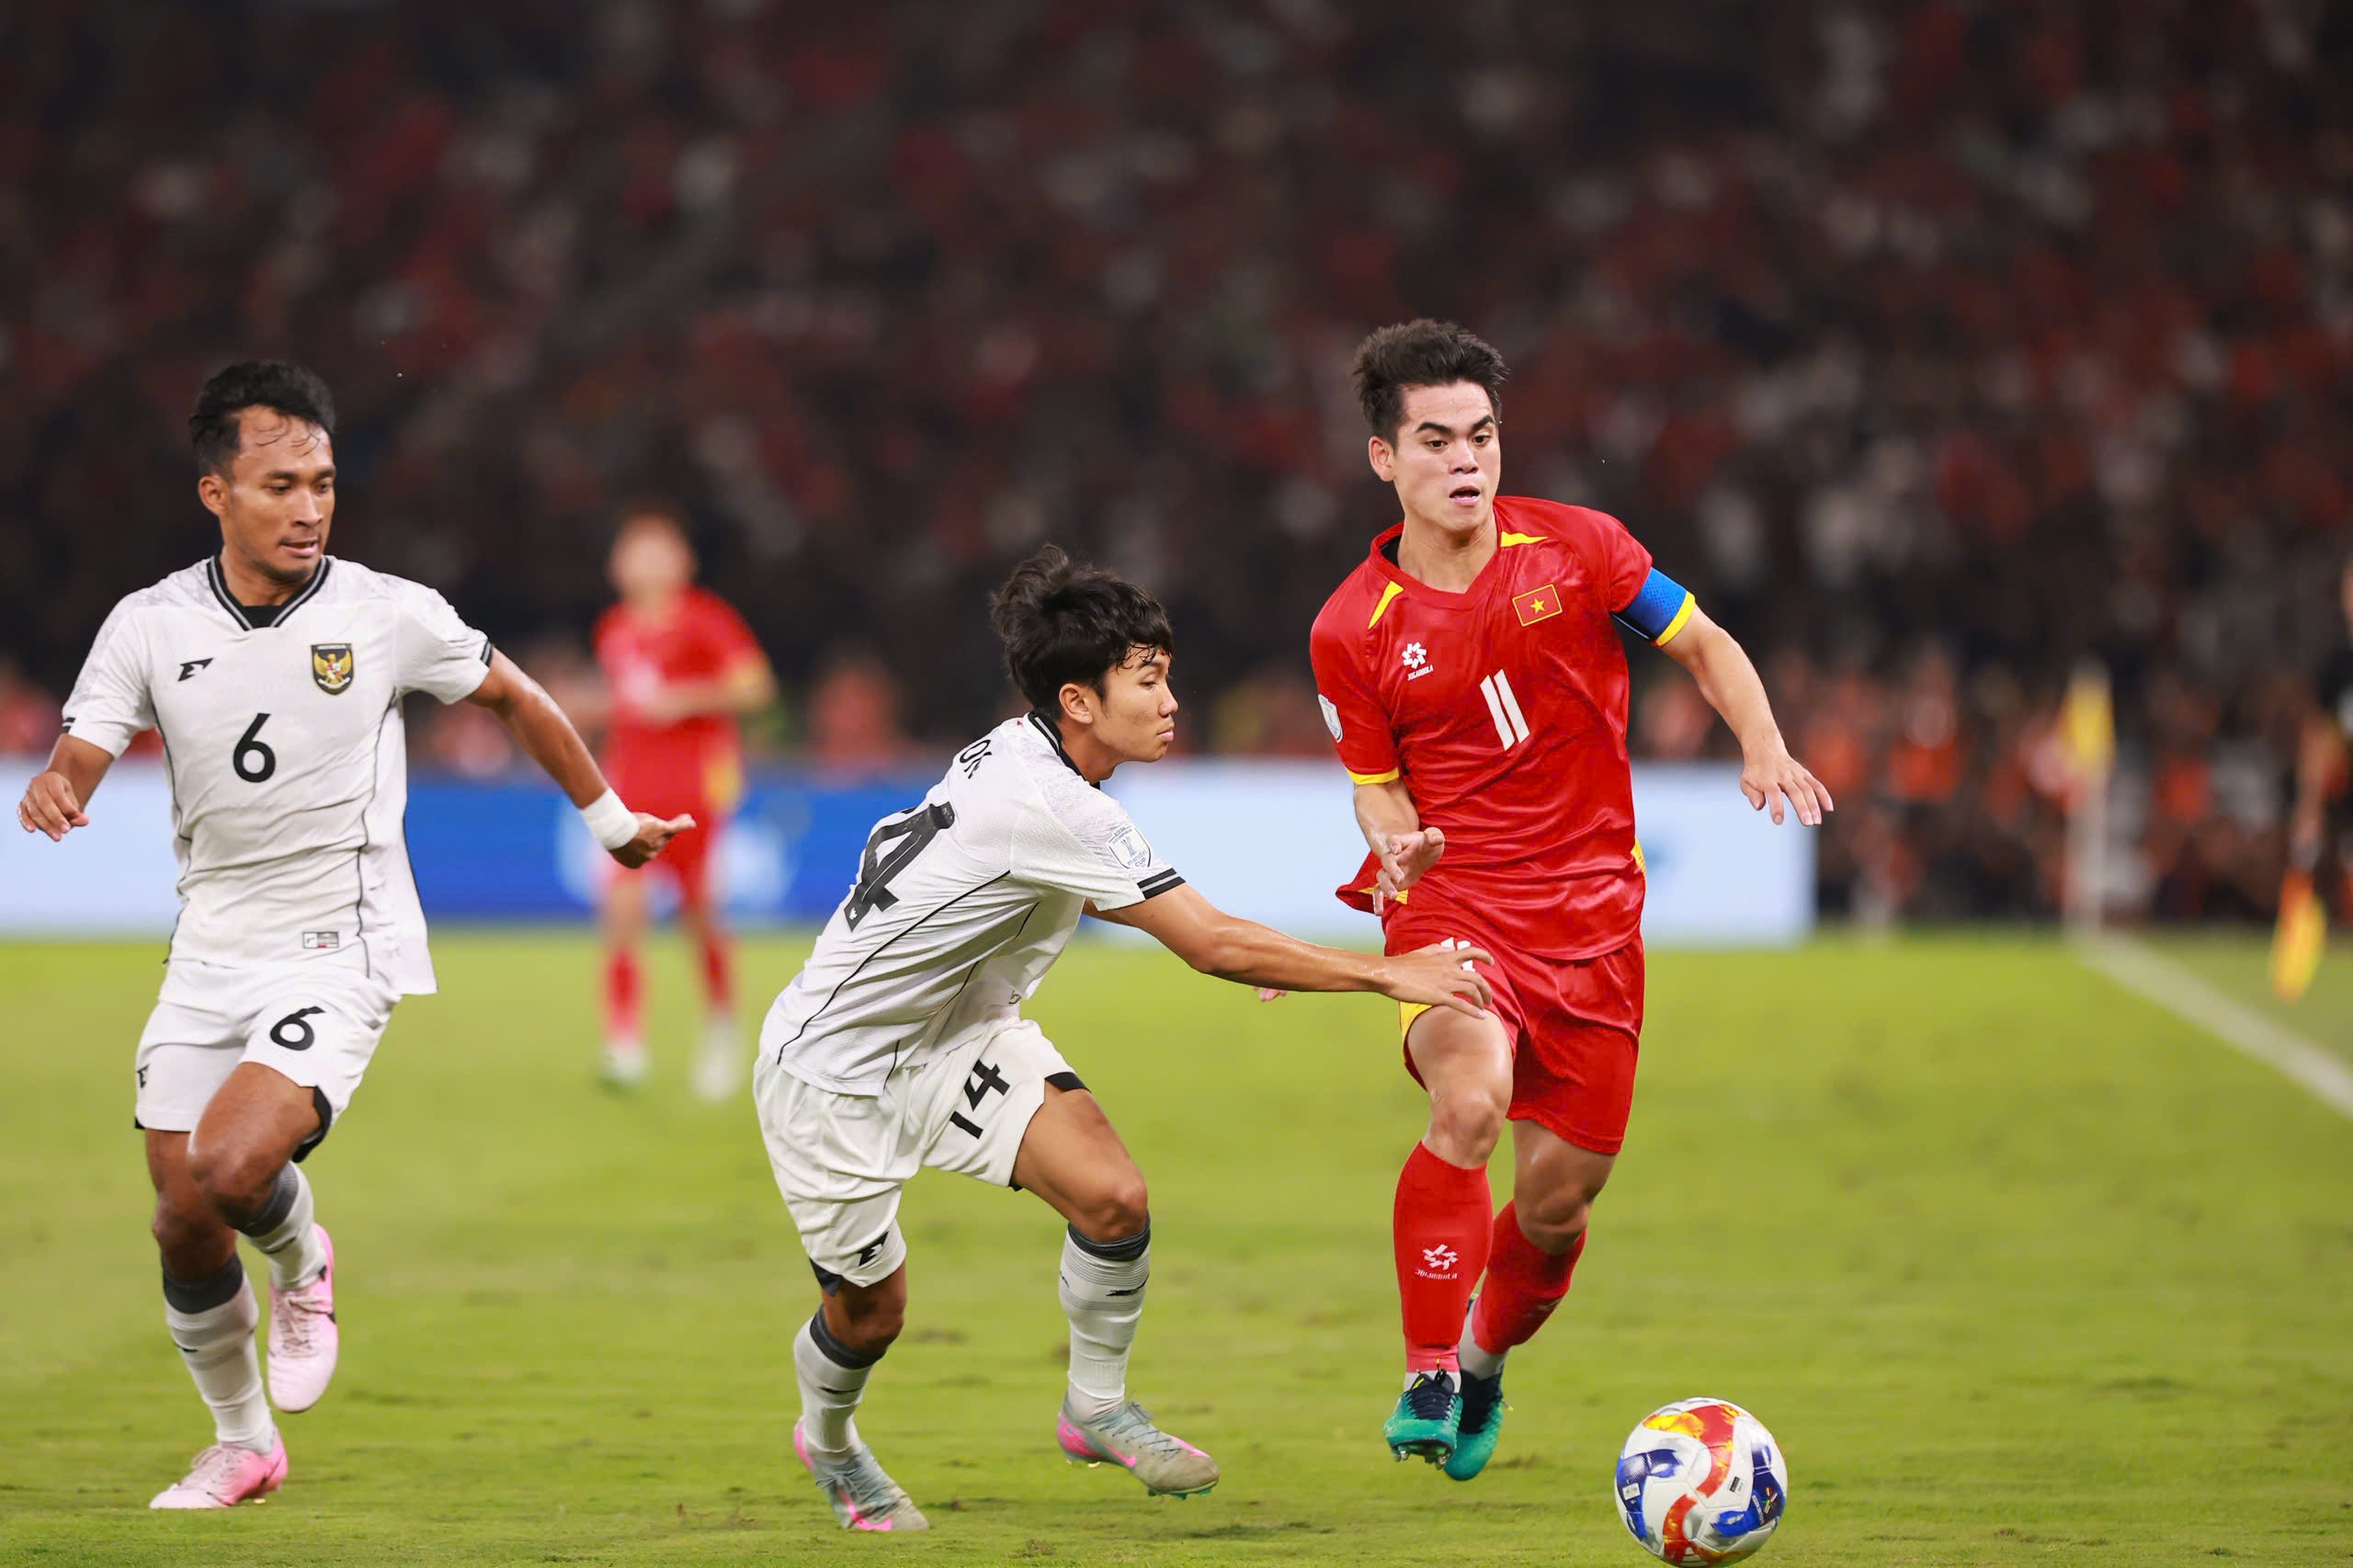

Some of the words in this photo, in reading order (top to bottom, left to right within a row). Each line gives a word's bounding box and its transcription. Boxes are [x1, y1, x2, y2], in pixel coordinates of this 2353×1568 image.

[233, 712, 277, 783] 6
[1480, 668, 1530, 751] 11
[844, 801, 955, 932] 4
[269, 1006, 326, 1051] 6
[949, 1058, 1011, 1141] 14
